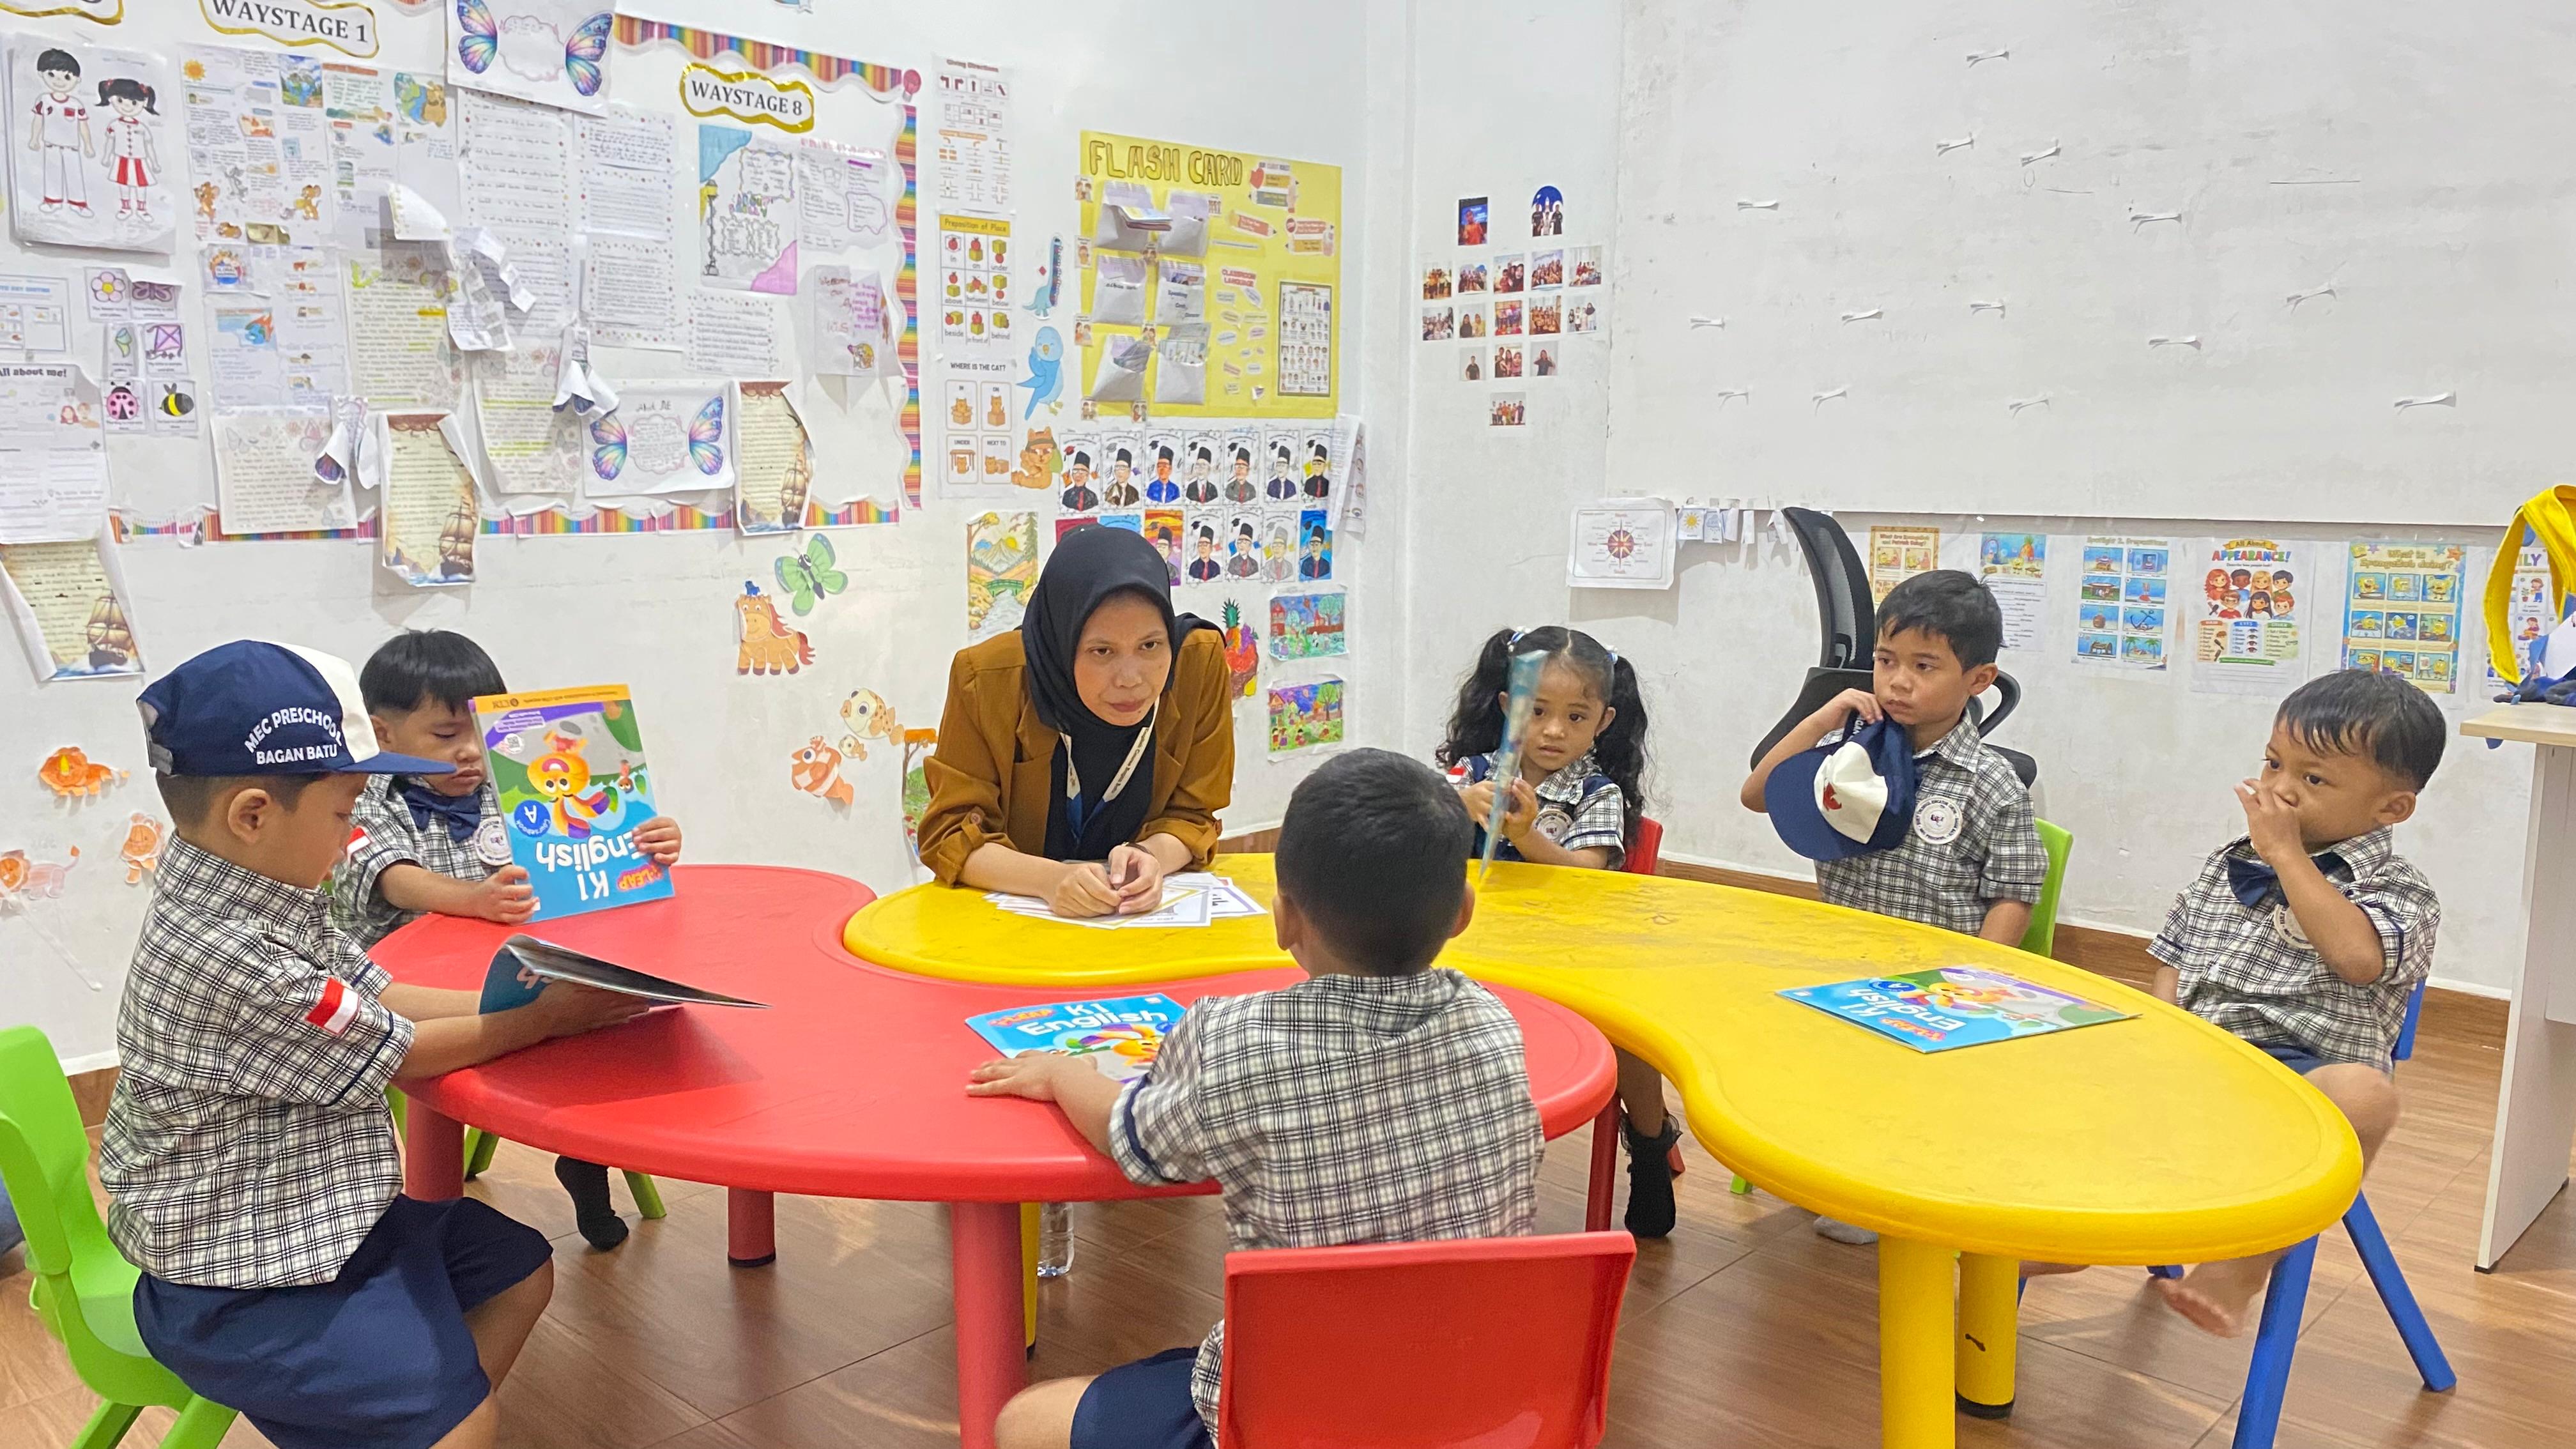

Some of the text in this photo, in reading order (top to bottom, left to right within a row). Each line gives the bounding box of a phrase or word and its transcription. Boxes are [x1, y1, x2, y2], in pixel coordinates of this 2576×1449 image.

[213, 0, 368, 43] WAYSTAGE 1
[691, 80, 802, 116] WAYSTAGE 8
[1089, 140, 1243, 186] FLASH CARD
[944, 218, 979, 230] Preposition
[990, 224, 1006, 233] Place
[991, 332, 1010, 341] behind
[13, 368, 43, 376] about
[2212, 550, 2292, 562] APPEARANCE!
[2518, 553, 2542, 567] ILY
[244, 707, 342, 753] MEC PRESCHOOL
[256, 744, 338, 765] BAGAN BATU
[523, 804, 537, 824] A
[577, 870, 610, 901] K1
[1063, 1003, 1110, 1016] K1
[1839, 1003, 1889, 1016] K1
[1847, 988, 1967, 1031] English
[1016, 1009, 1169, 1036] English
